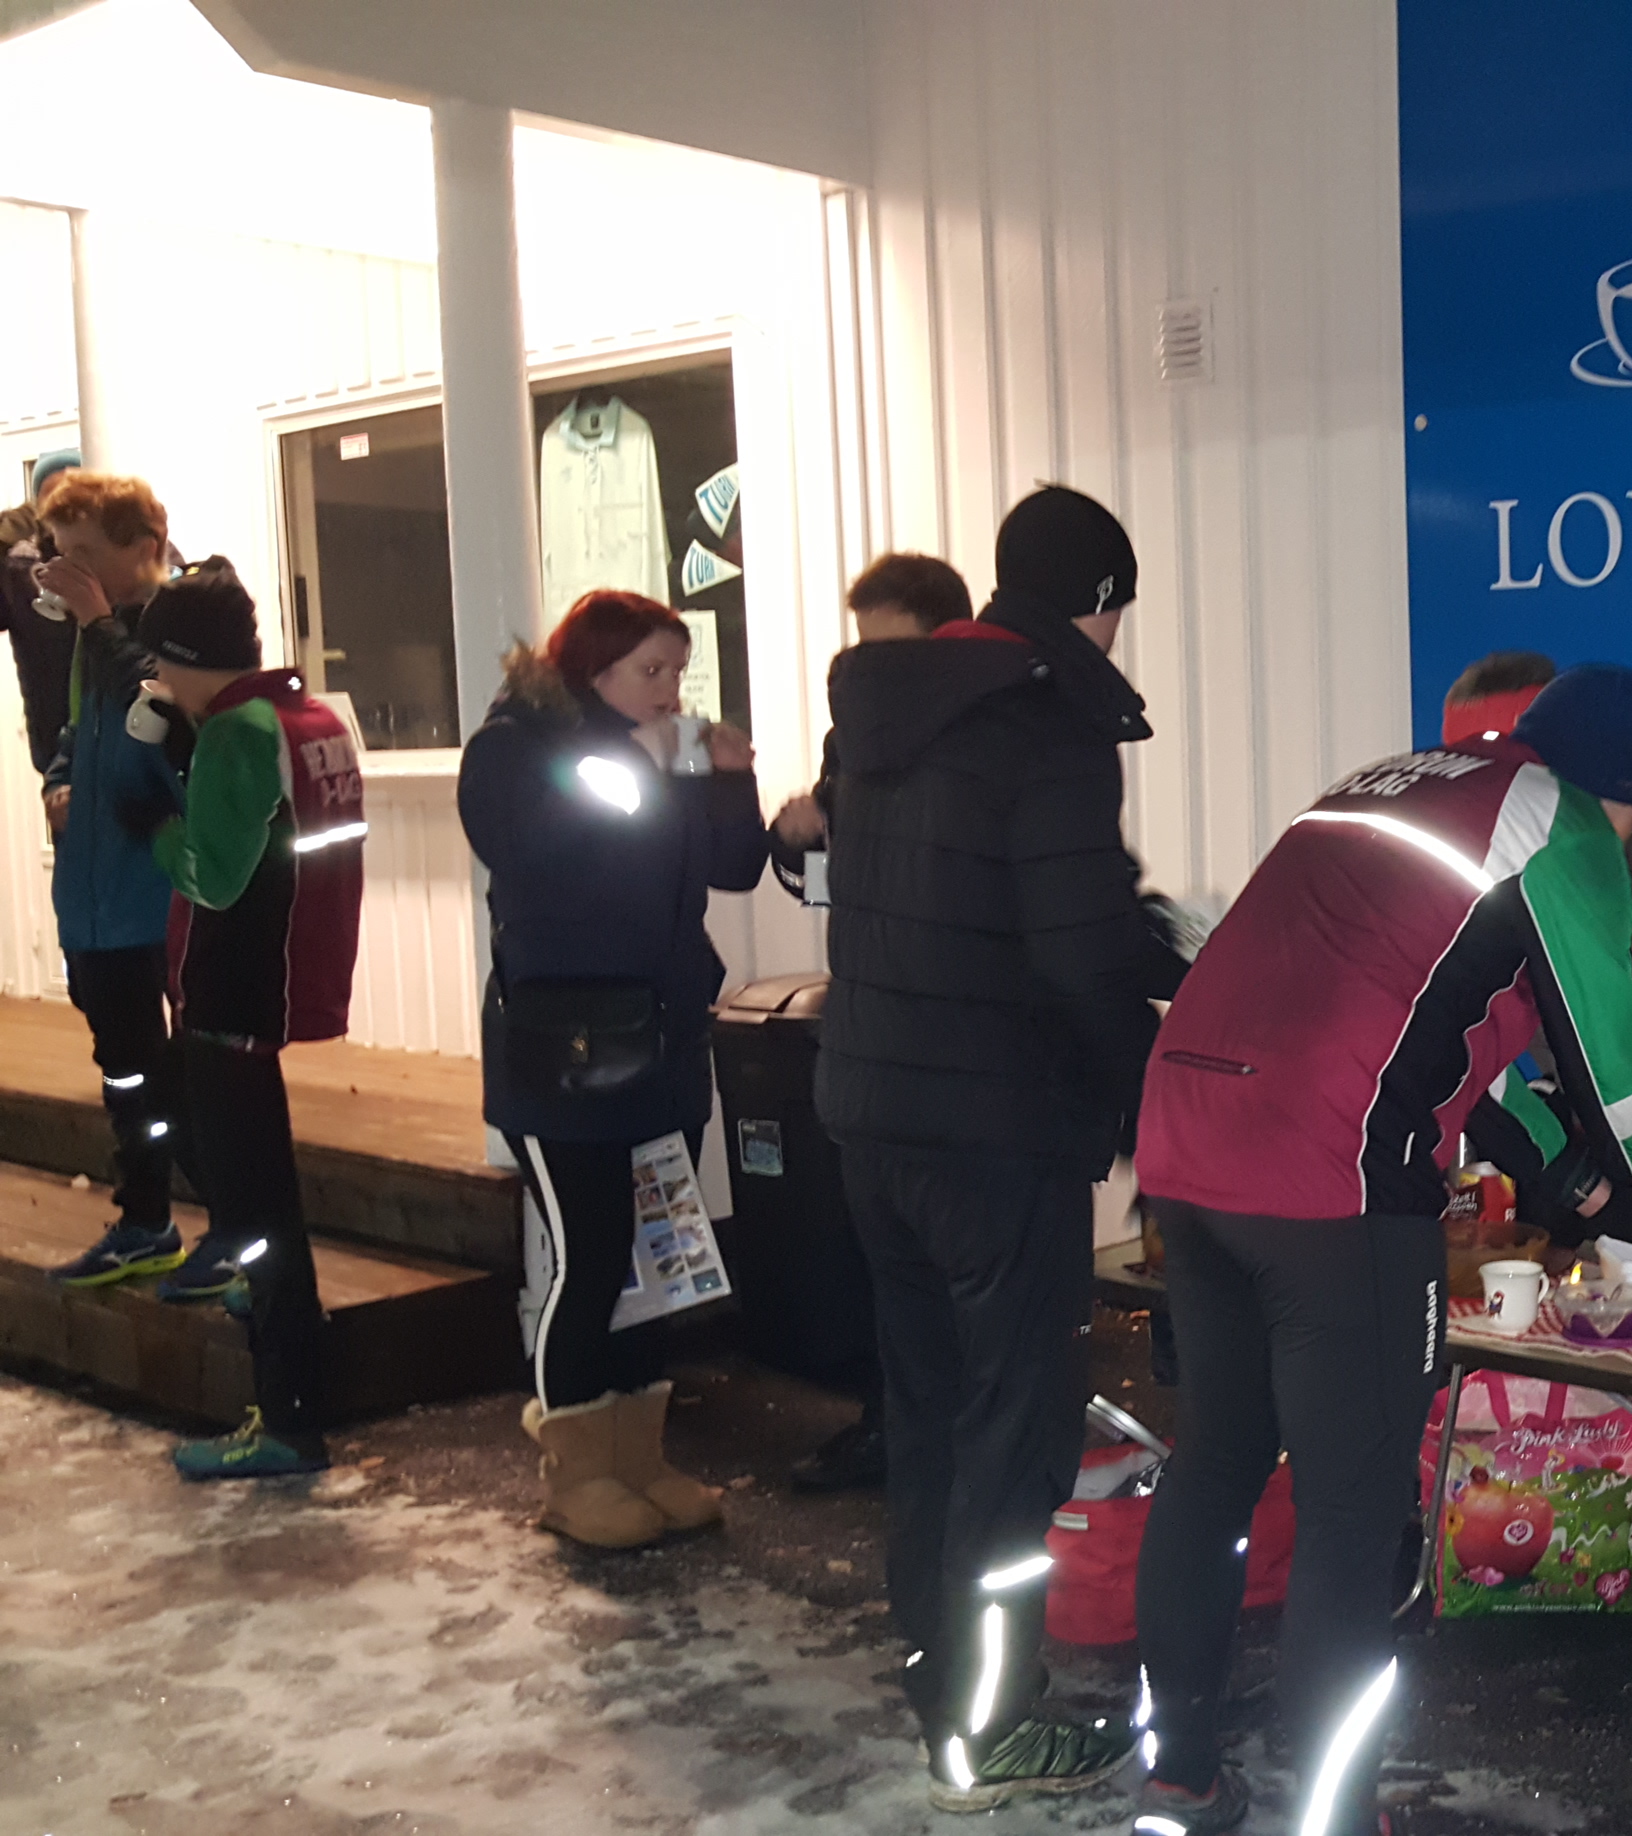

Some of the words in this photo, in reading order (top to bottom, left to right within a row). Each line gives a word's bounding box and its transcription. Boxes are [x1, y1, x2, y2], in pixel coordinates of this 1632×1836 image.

[699, 474, 736, 525] TURN
[688, 546, 716, 589] TURN
[1423, 1280, 1438, 1374] bagheera
[1495, 1425, 1566, 1455] Pink
[1568, 1419, 1630, 1446] Lady
